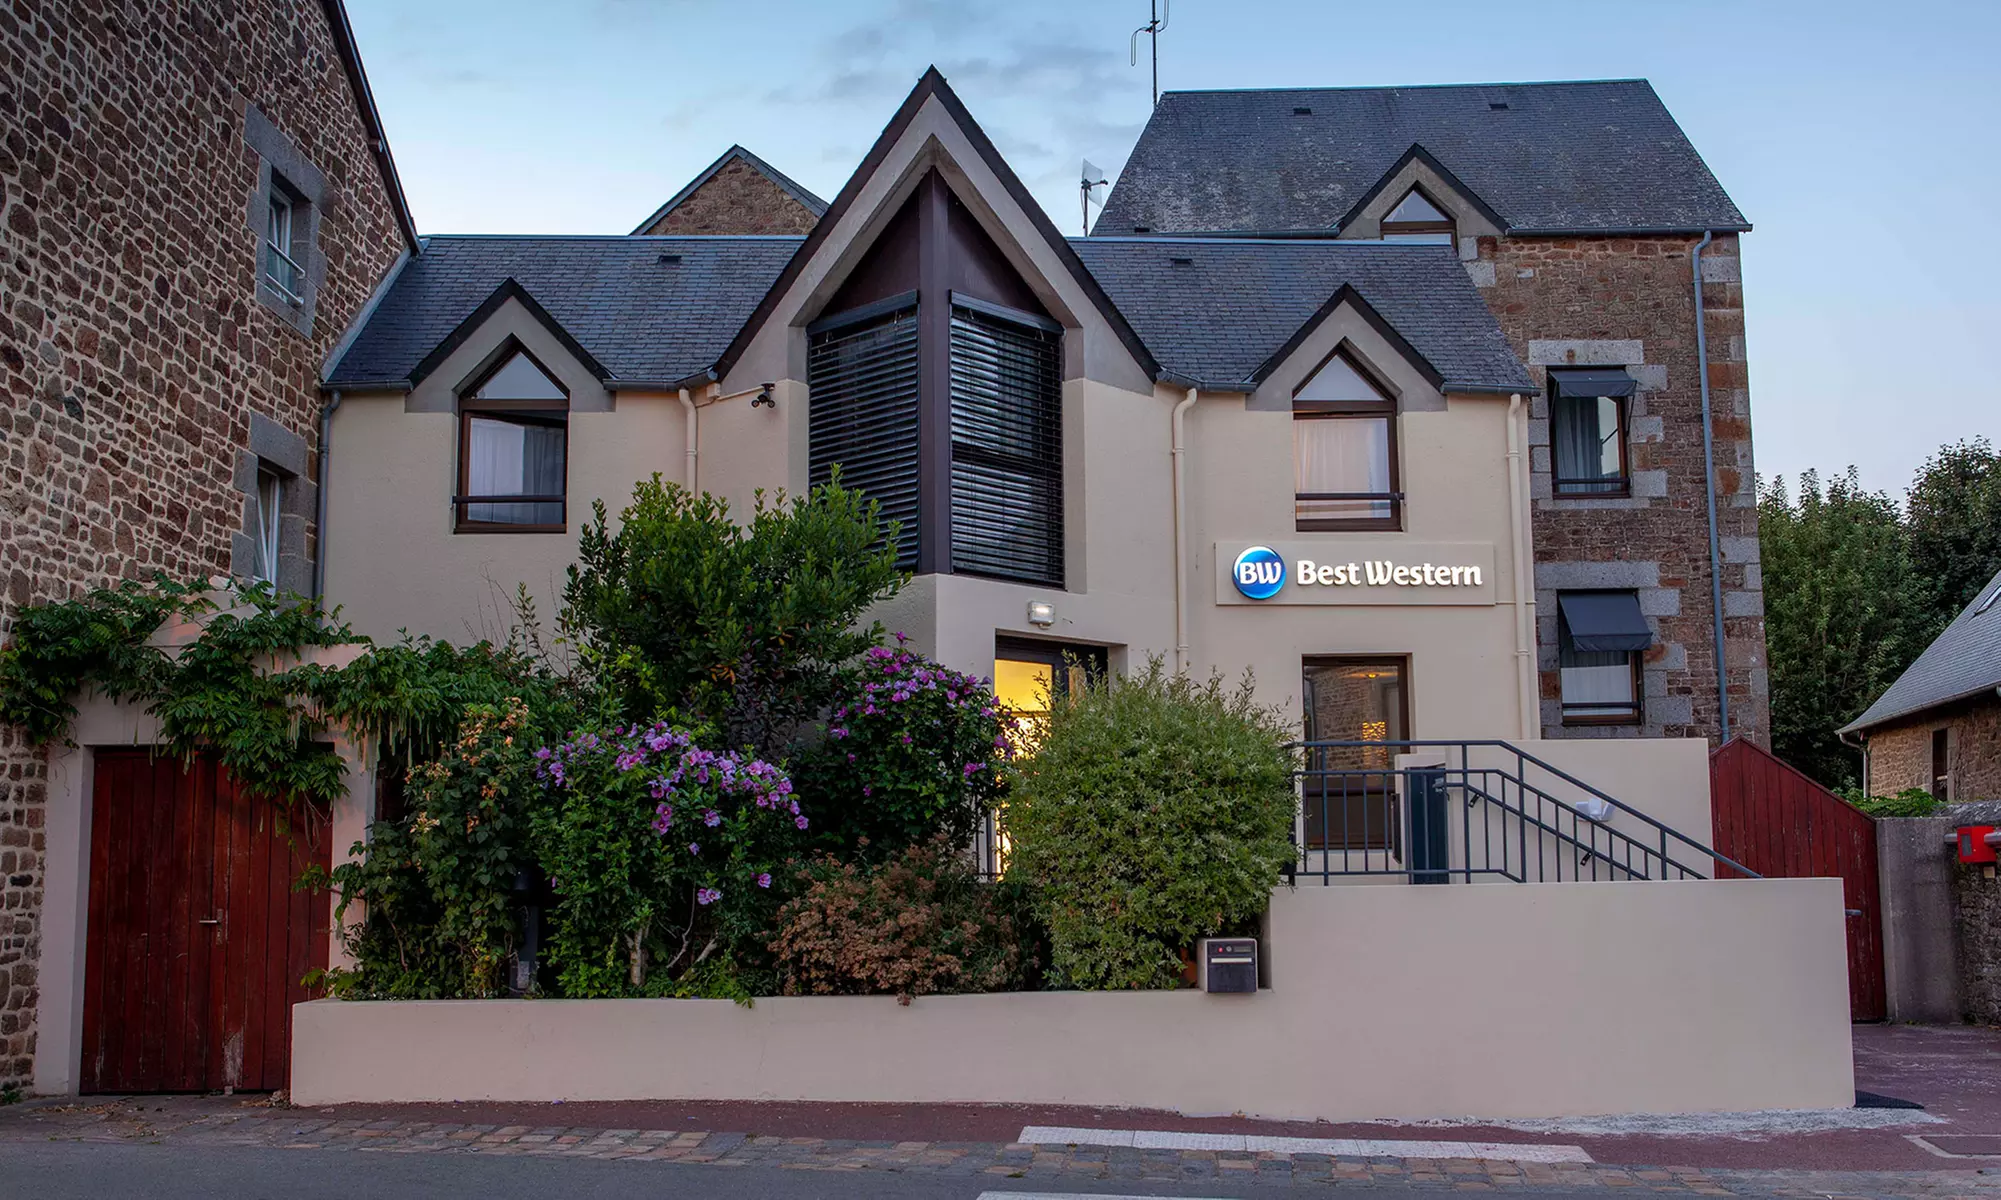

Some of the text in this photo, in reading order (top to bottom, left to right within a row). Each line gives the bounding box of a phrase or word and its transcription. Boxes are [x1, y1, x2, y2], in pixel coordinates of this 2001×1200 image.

[1239, 560, 1483, 586] BW Best Western
